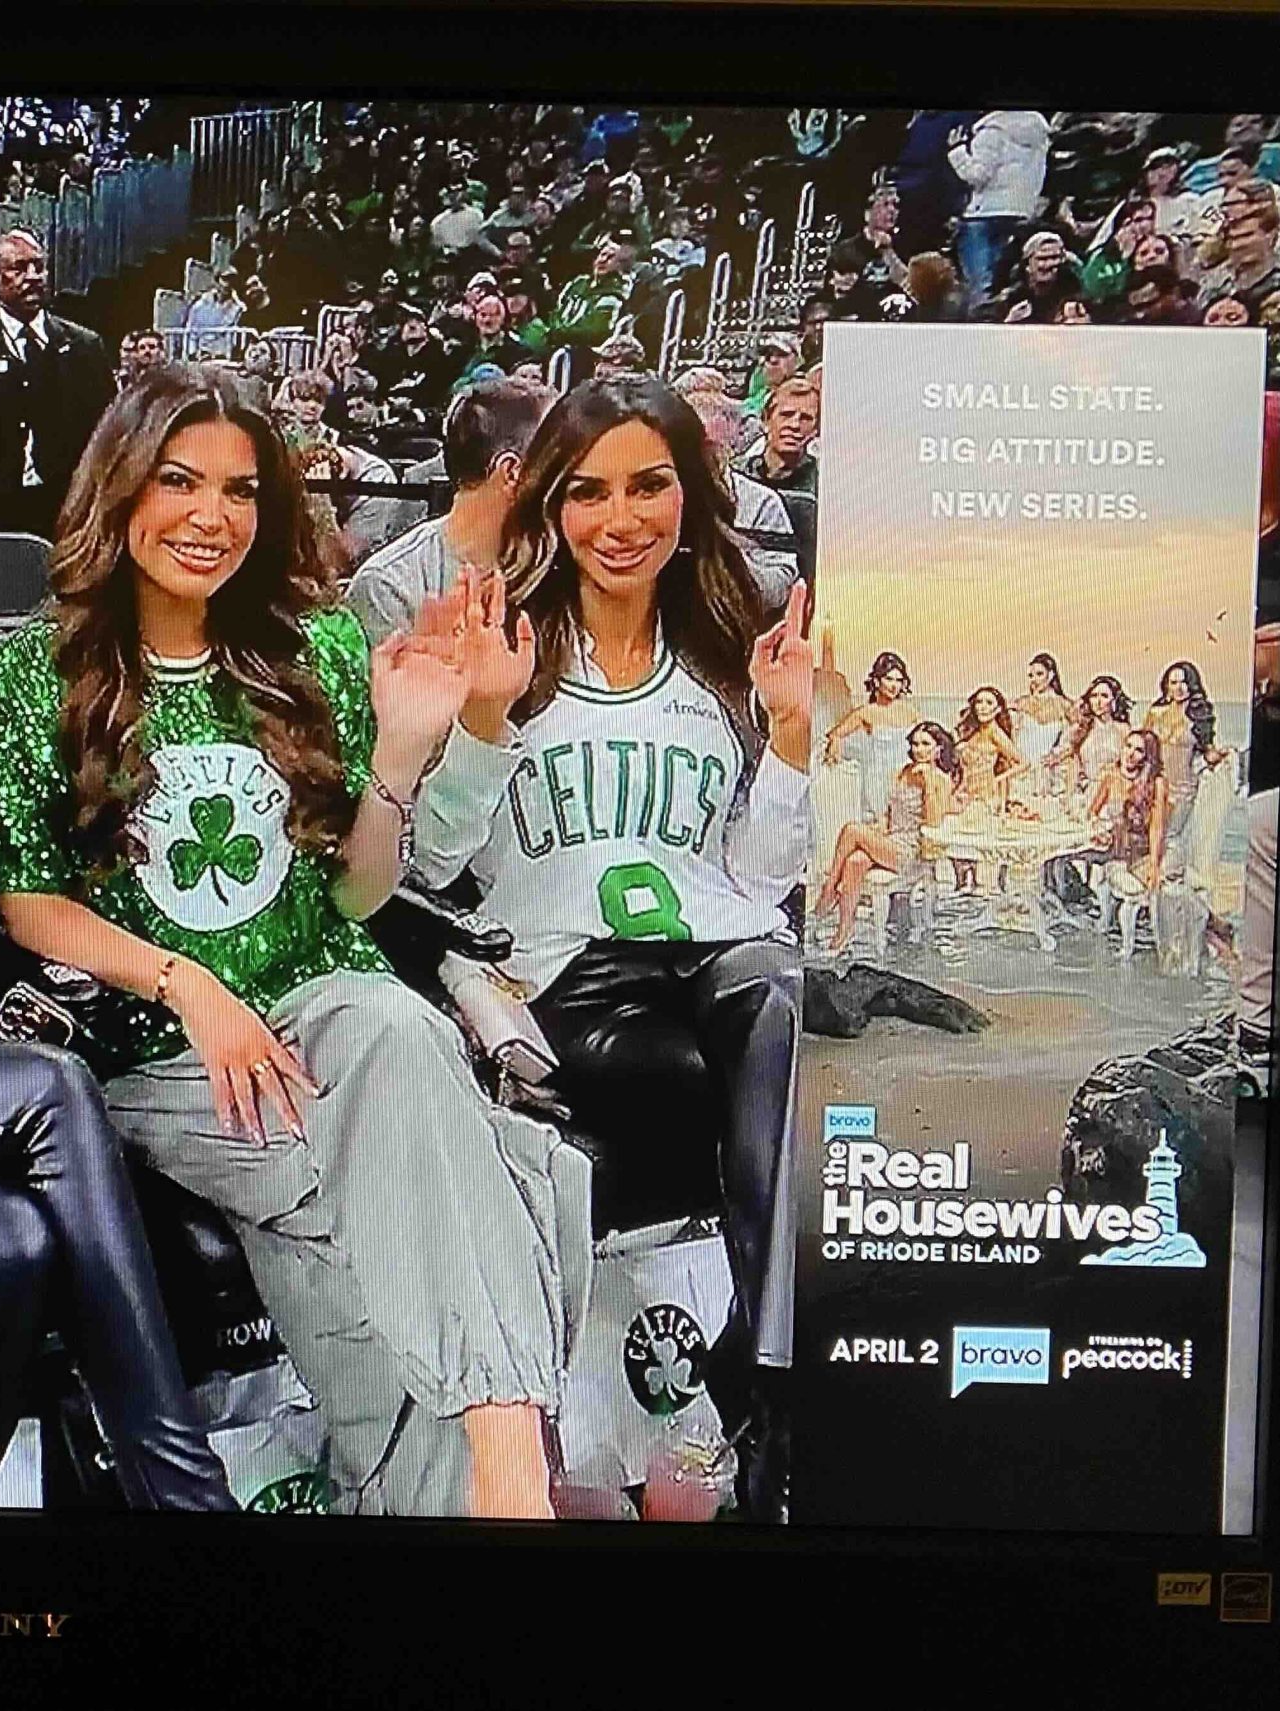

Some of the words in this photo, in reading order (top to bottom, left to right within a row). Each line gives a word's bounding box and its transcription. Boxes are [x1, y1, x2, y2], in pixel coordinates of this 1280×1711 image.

[923, 383, 1040, 410] SMALL
[1049, 384, 1164, 412] STATE.
[918, 436, 977, 464] BIG
[987, 438, 1166, 467] ATTITUDE.
[931, 492, 1013, 518] NEW
[1020, 493, 1148, 521] SERIES.
[507, 741, 726, 860] CELTICS
[829, 1113, 870, 1127] bravo
[822, 1140, 848, 1188] the
[847, 1141, 970, 1190] Real
[822, 1188, 1163, 1242] Housewives
[822, 1240, 856, 1262] OF
[860, 1241, 946, 1263] RHODE
[950, 1243, 1042, 1264] ISLAND
[829, 1337, 915, 1364] APRIL
[919, 1338, 940, 1365] 2
[960, 1340, 1043, 1367] bravo
[1061, 1343, 1181, 1380] peacock
